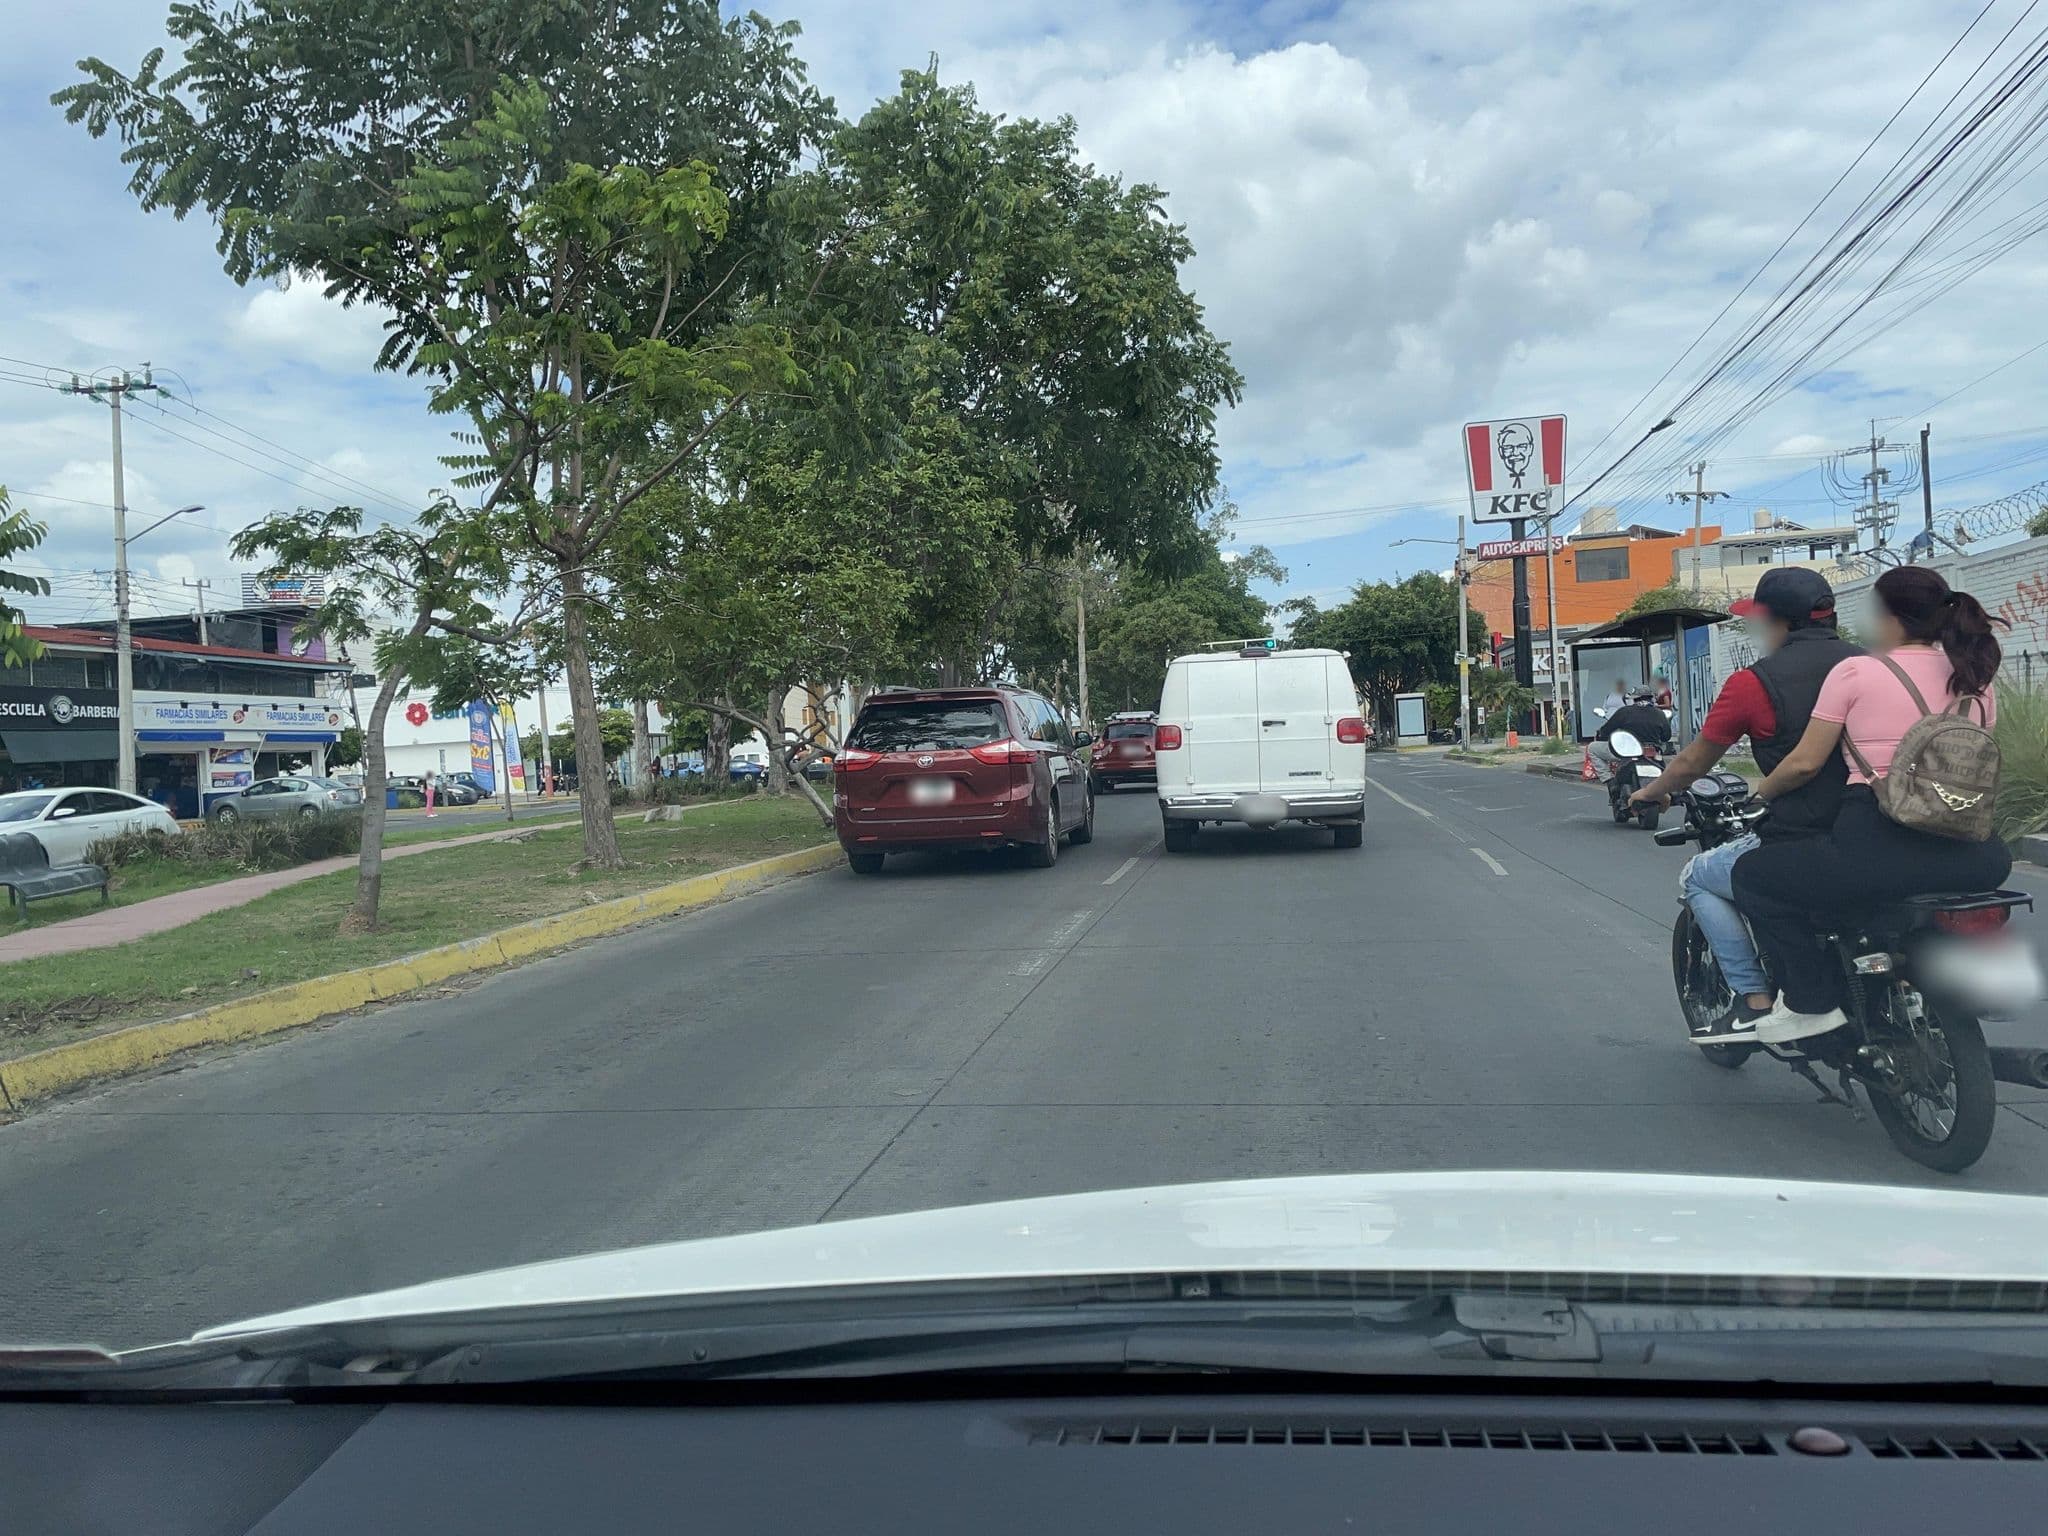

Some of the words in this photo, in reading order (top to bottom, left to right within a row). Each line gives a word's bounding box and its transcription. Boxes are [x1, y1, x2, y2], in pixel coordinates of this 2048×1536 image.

[1488, 491, 1552, 515] KFC
[156, 708, 193, 719] FARMACIAS
[195, 709, 228, 720] SIMILARES
[266, 711, 297, 721] FARMACIAS
[298, 712, 325, 722] SIMILARES
